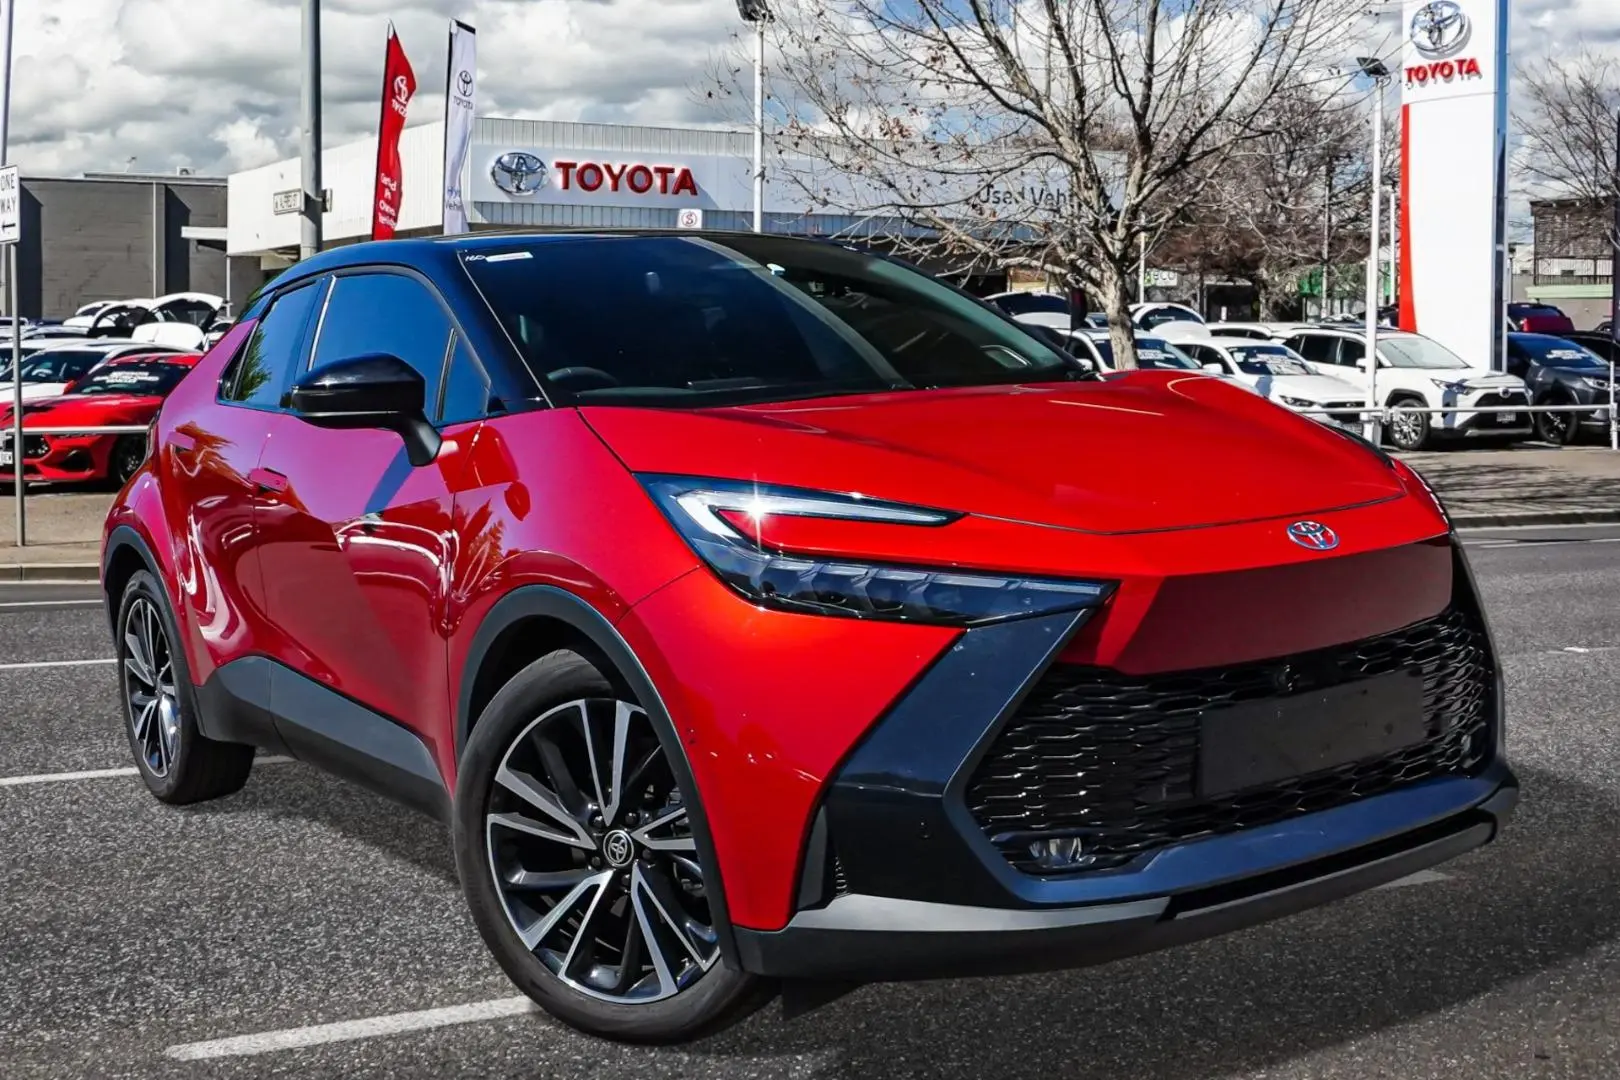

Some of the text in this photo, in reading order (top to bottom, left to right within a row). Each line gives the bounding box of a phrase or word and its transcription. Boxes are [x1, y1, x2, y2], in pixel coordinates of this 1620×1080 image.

[1404, 58, 1480, 83] TOYOTA
[1, 173, 15, 191] ONE
[554, 161, 698, 196] TOYOTA
[1, 196, 16, 214] WAY
